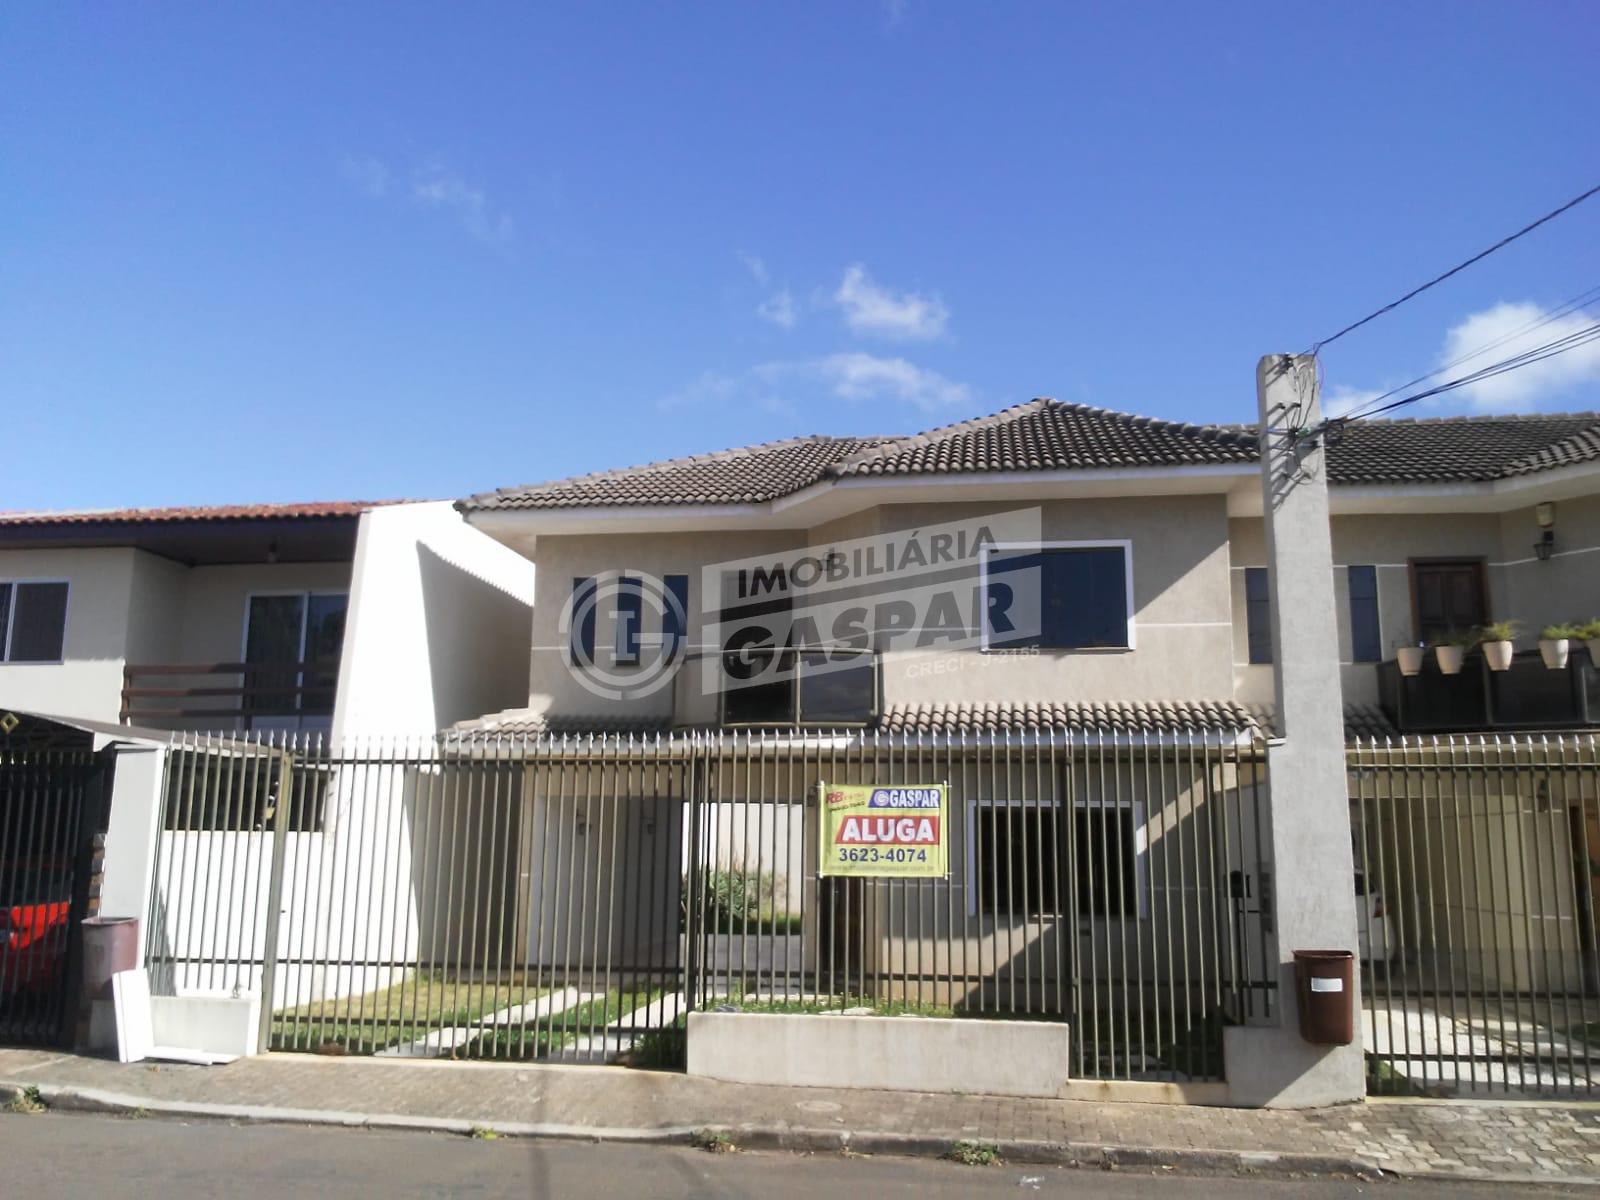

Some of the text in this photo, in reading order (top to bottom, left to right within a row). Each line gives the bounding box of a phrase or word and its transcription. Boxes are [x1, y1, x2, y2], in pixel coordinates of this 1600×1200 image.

[889, 789, 940, 808] GASPAR
[841, 818, 935, 842] ALUGA
[839, 847, 927, 863] 3623-4074
